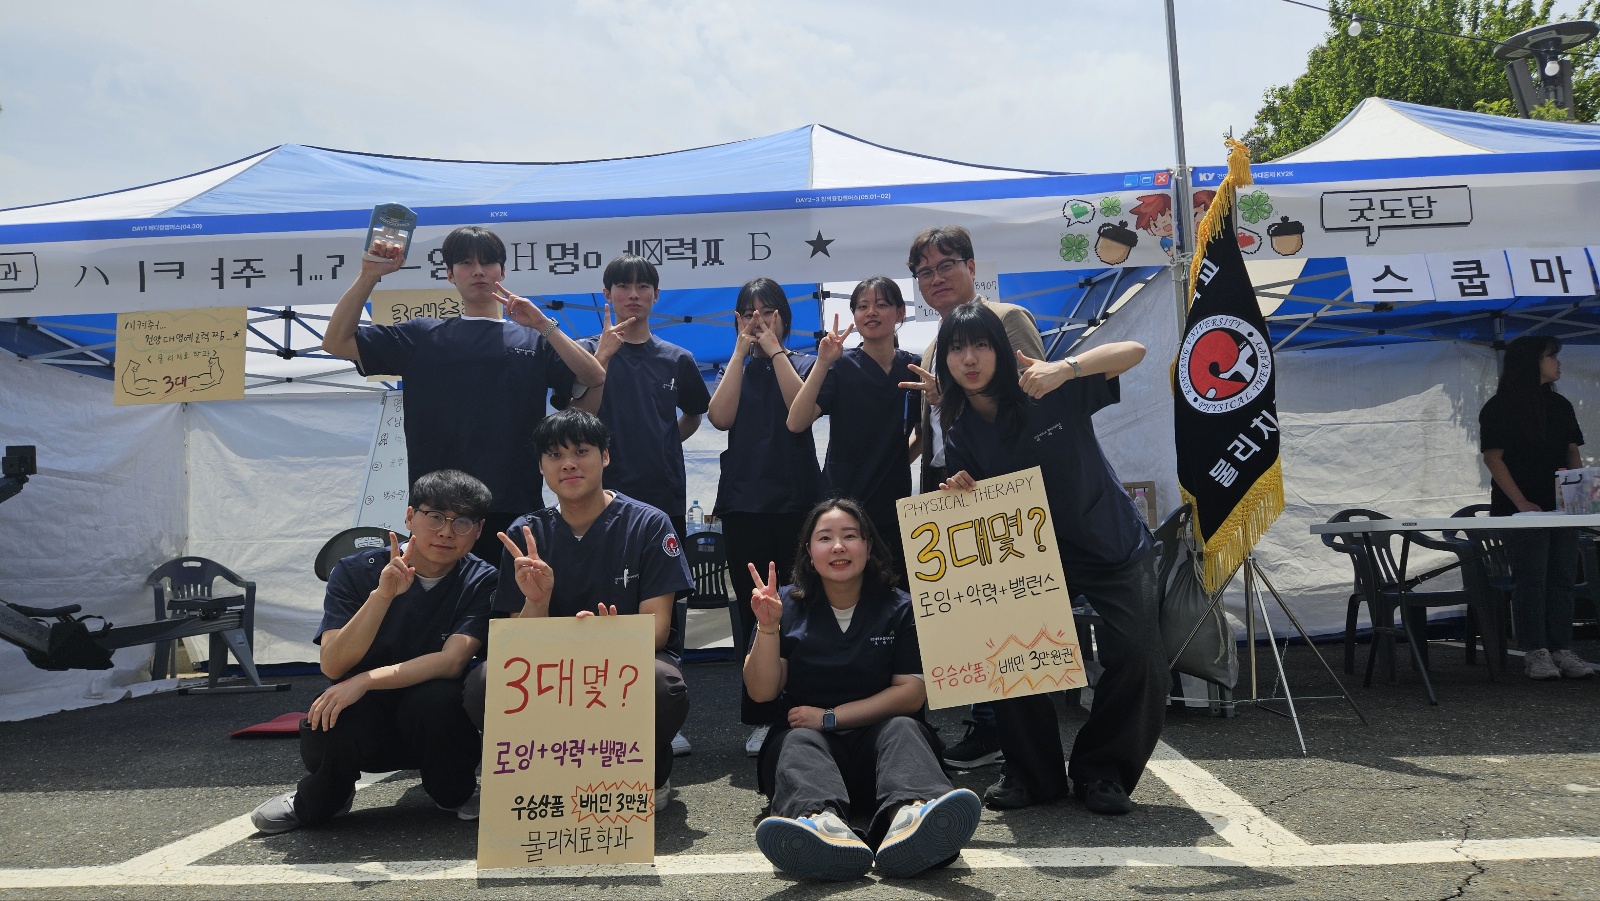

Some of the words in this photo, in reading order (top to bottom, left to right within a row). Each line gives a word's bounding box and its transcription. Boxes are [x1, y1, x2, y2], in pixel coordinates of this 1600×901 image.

[1276, 170, 1294, 178] KY2K
[1349, 195, 1437, 222] 굿도담
[1186, 317, 1245, 345] UNIVERSITY
[163, 375, 187, 393] 3대
[1198, 392, 1253, 412] PHYSICAL
[1252, 341, 1270, 391] THERAPY
[903, 493, 971, 518] PHYSICAL
[972, 475, 1034, 504] THERAPY
[919, 573, 1060, 618] 로잉+악력+밸런스
[998, 655, 1025, 675] 배민
[1028, 647, 1074, 670] 3만원권
[510, 794, 565, 821] 우승상품
[579, 793, 612, 814] 배민
[616, 793, 649, 814] 3만원
[521, 825, 634, 863] 물리치료학과
